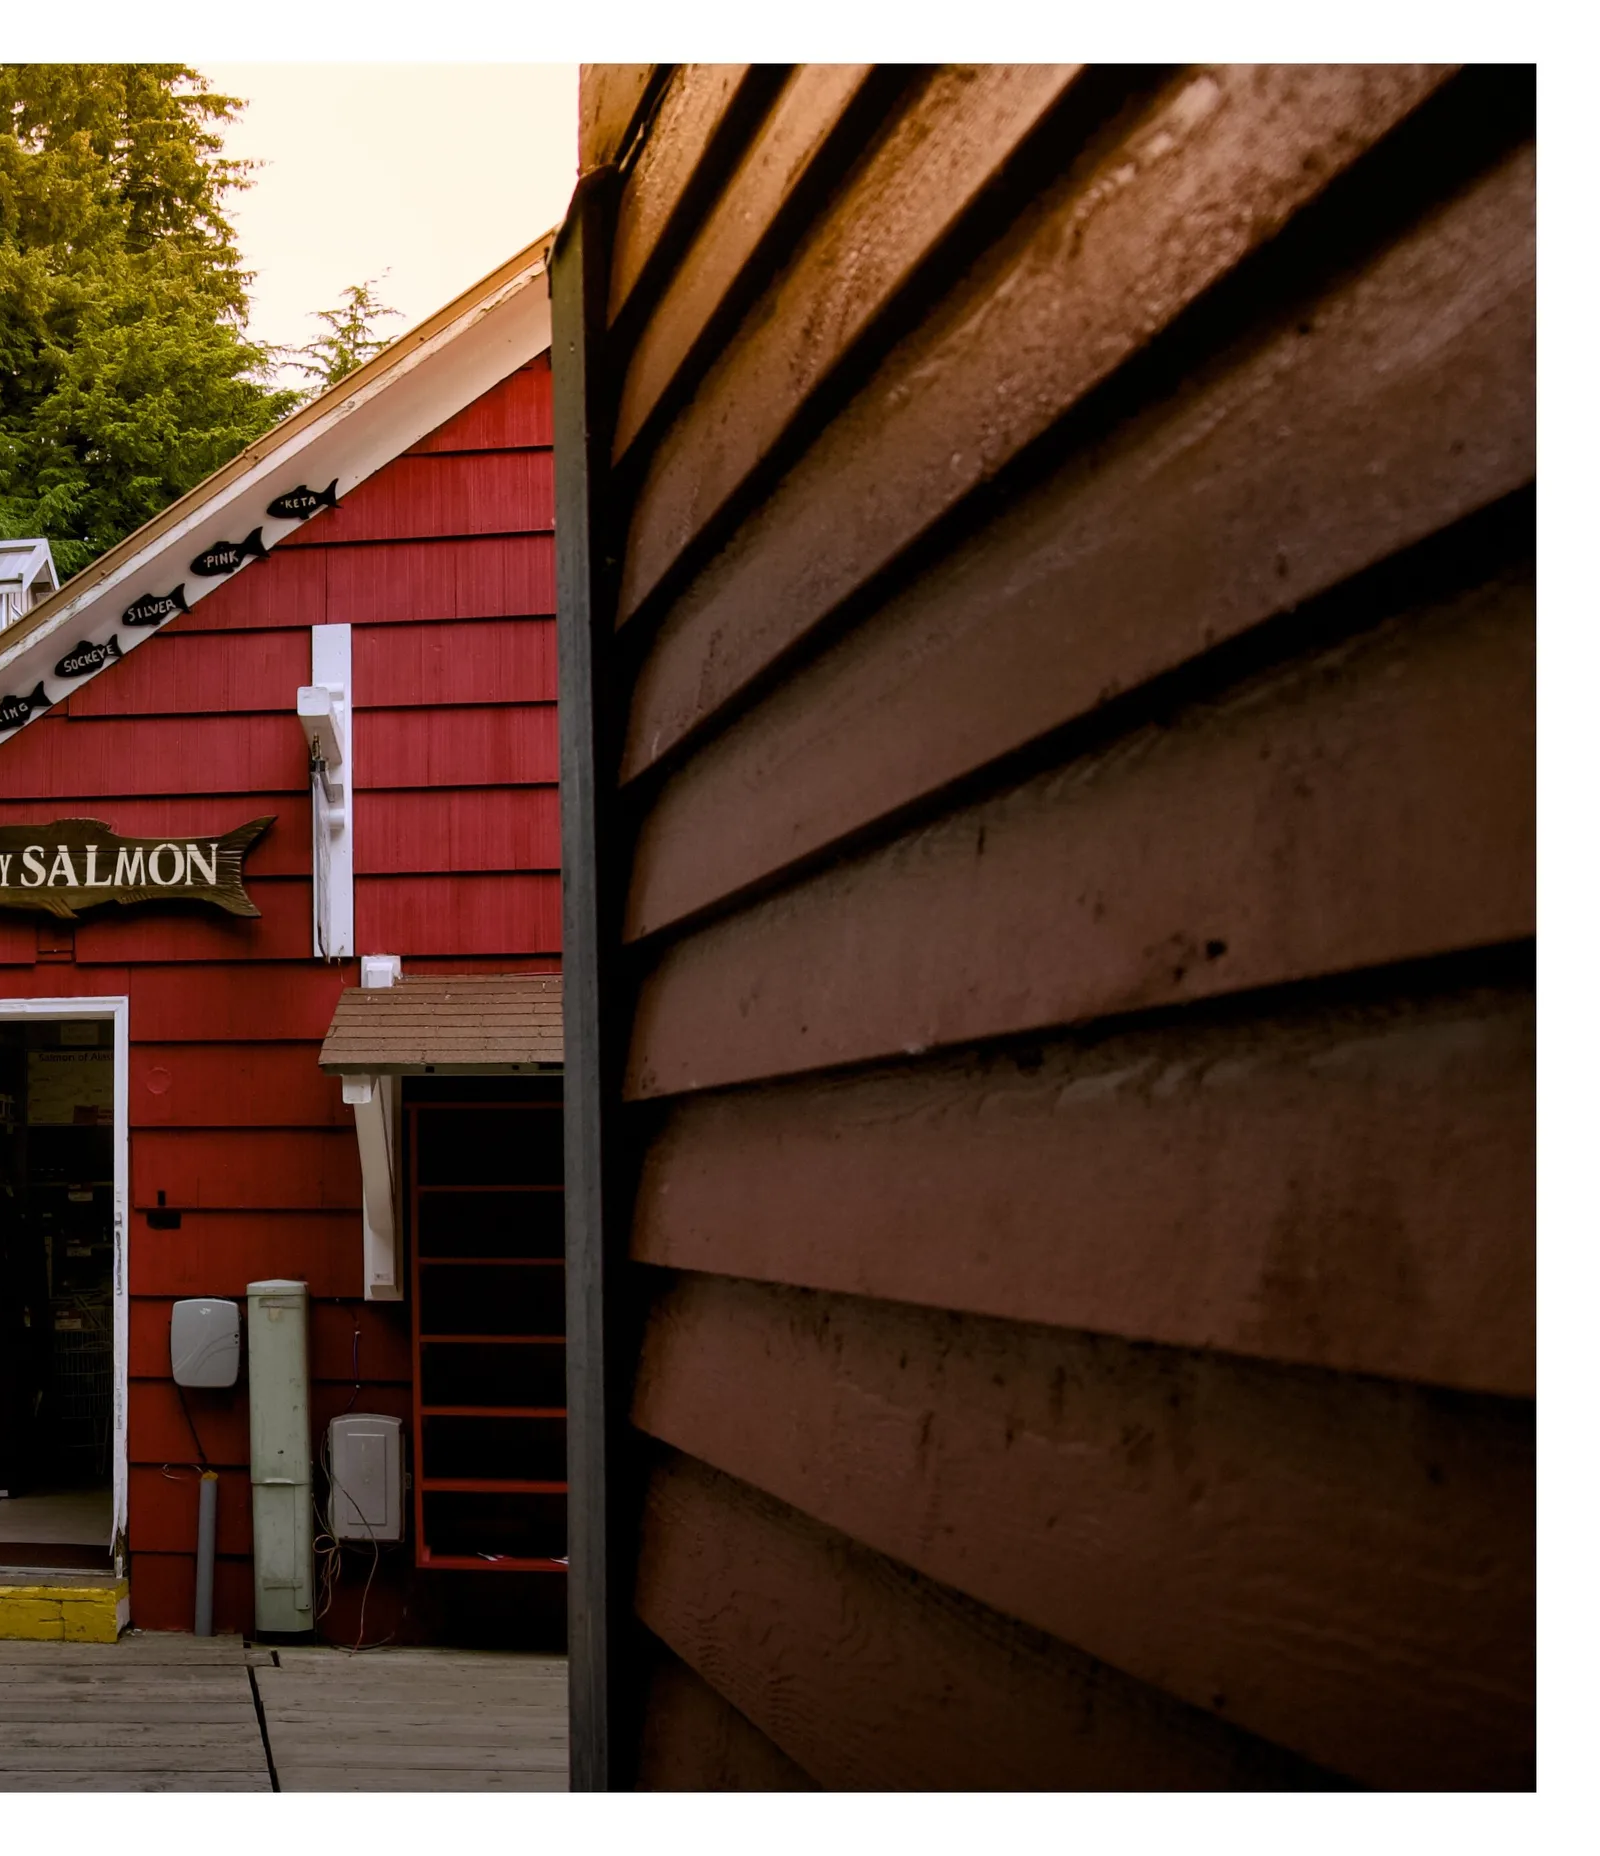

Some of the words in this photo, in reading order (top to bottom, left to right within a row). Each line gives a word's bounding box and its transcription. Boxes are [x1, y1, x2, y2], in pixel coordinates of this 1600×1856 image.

[285, 496, 316, 509] KETA
[206, 551, 239, 567] PINK
[127, 599, 176, 622] SILVER
[63, 643, 116, 673] SOCKEYE
[20, 843, 219, 887] SALMON
